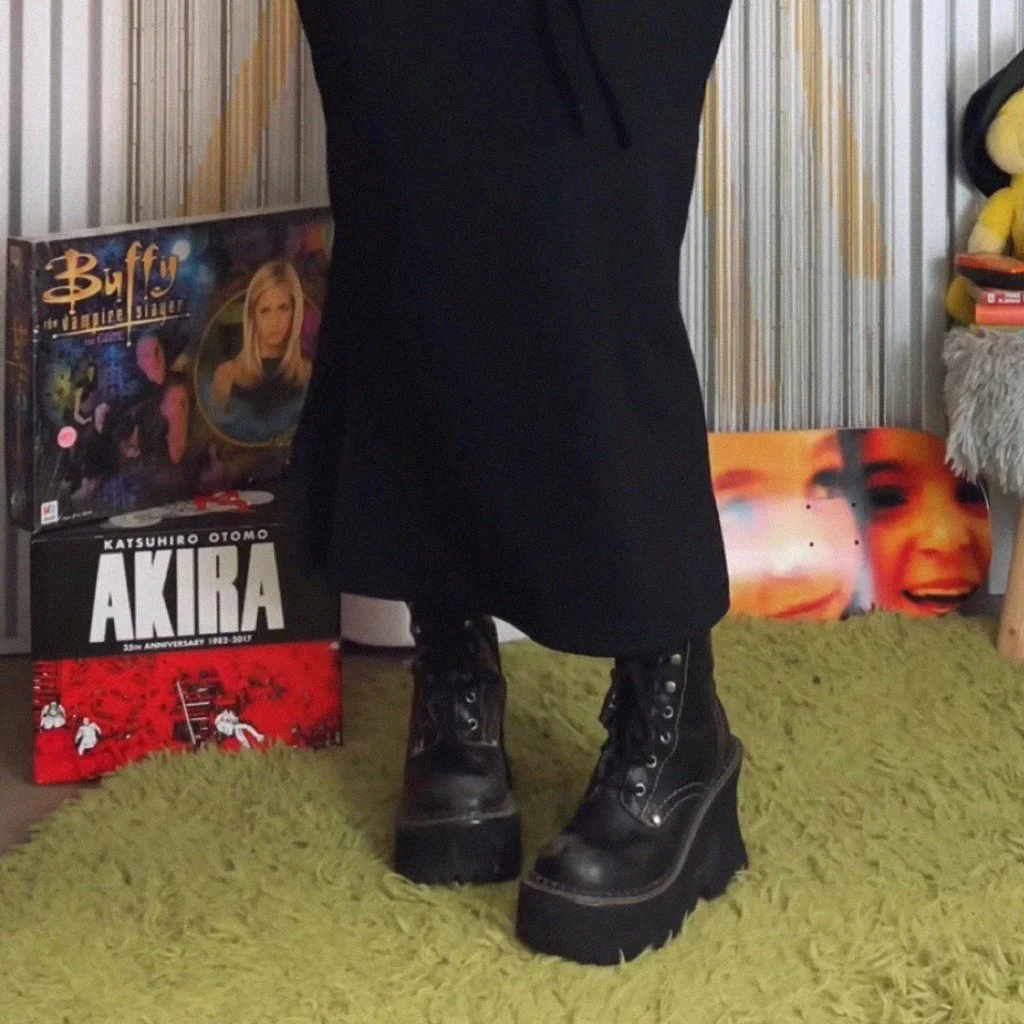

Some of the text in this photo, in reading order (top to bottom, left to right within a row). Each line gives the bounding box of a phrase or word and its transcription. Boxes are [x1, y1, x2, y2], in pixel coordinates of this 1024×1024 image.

[43, 240, 179, 347] Buffy
[103, 529, 268, 550] KATSUHIRO OTOMO
[88, 542, 285, 643] AKIRA
[144, 639, 205, 650] ANNIVERSARY
